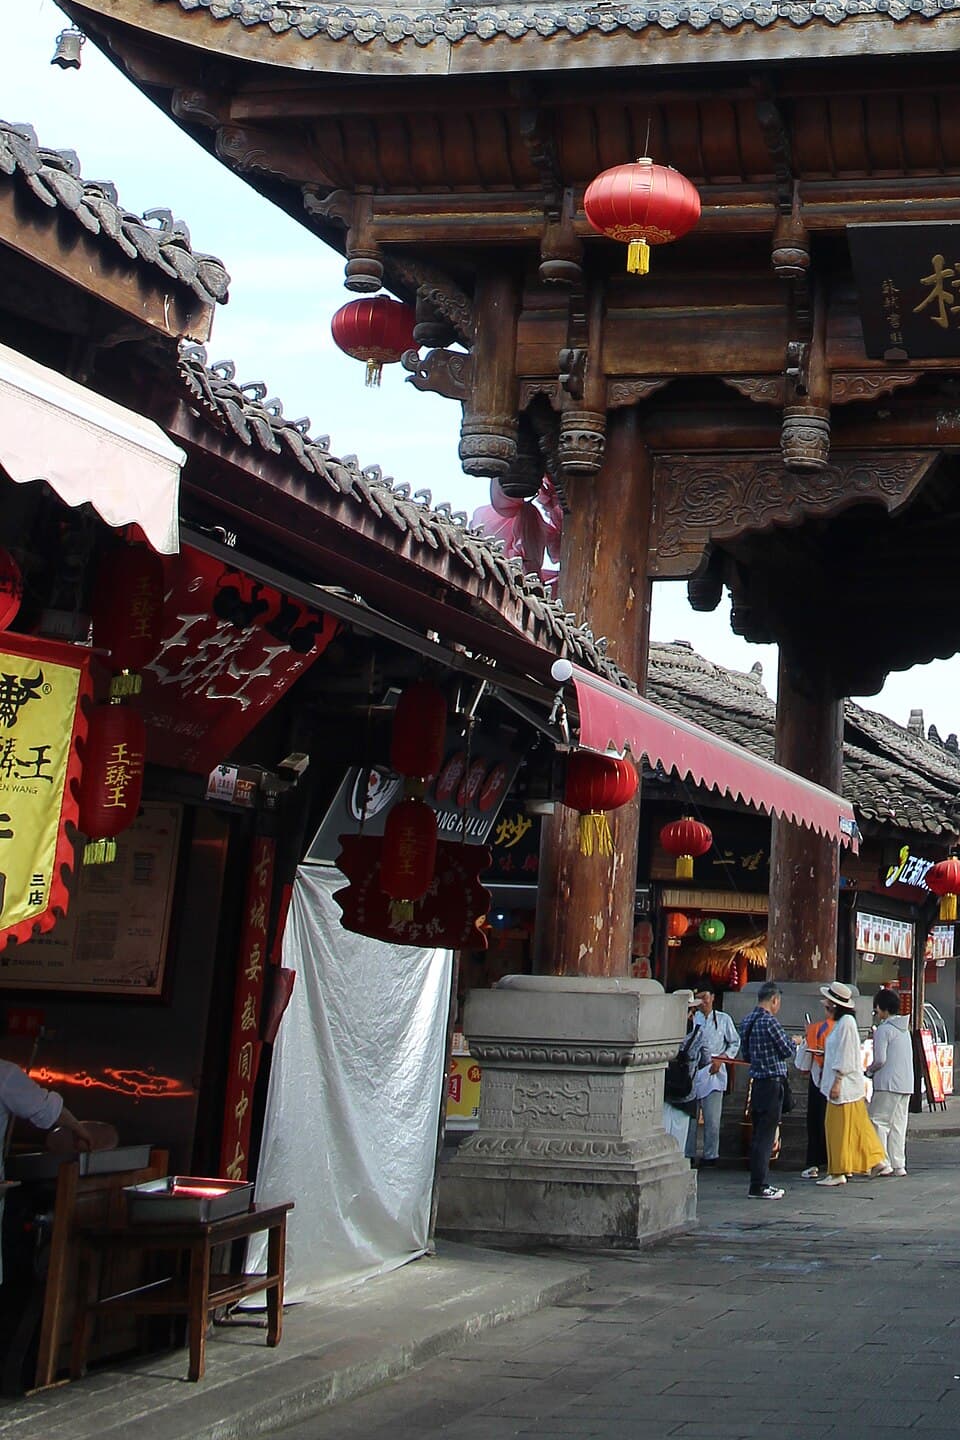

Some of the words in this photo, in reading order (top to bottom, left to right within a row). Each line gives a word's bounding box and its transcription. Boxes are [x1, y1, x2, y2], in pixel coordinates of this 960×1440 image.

[103, 742, 133, 808] 王臻王
[494, 812, 533, 849] 炒
[28, 874, 45, 906] 三店
